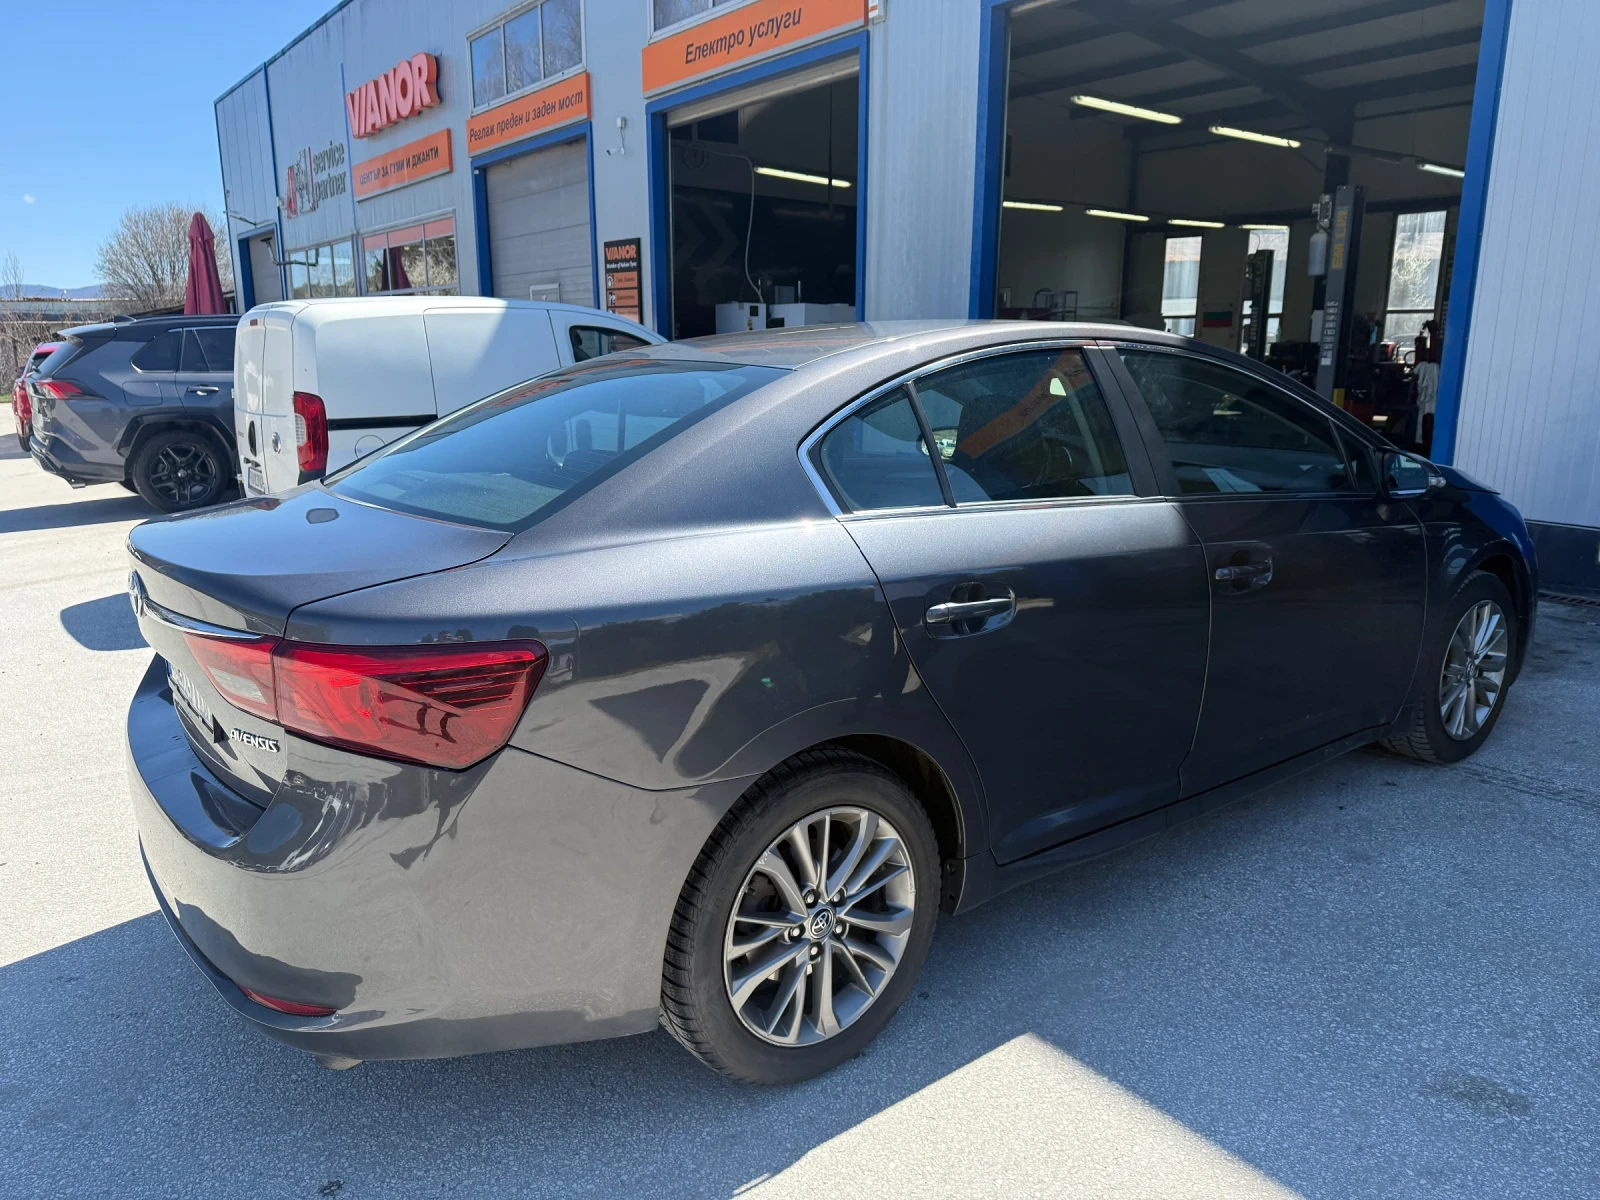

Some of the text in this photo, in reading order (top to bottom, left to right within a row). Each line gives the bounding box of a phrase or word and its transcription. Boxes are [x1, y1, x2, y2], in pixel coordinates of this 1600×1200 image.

[685, 8, 802, 65] Електро услуги
[345, 51, 439, 139] VIANOR
[469, 90, 583, 143] Реглаж преден и заден мост
[313, 140, 345, 175] service
[359, 146, 439, 186] ЦЕНТЪР ЗА ГУМИ И ДЖАНТИ
[314, 171, 347, 208] partner
[606, 245, 636, 260] VIANOR
[229, 728, 279, 753] AVENSIS
